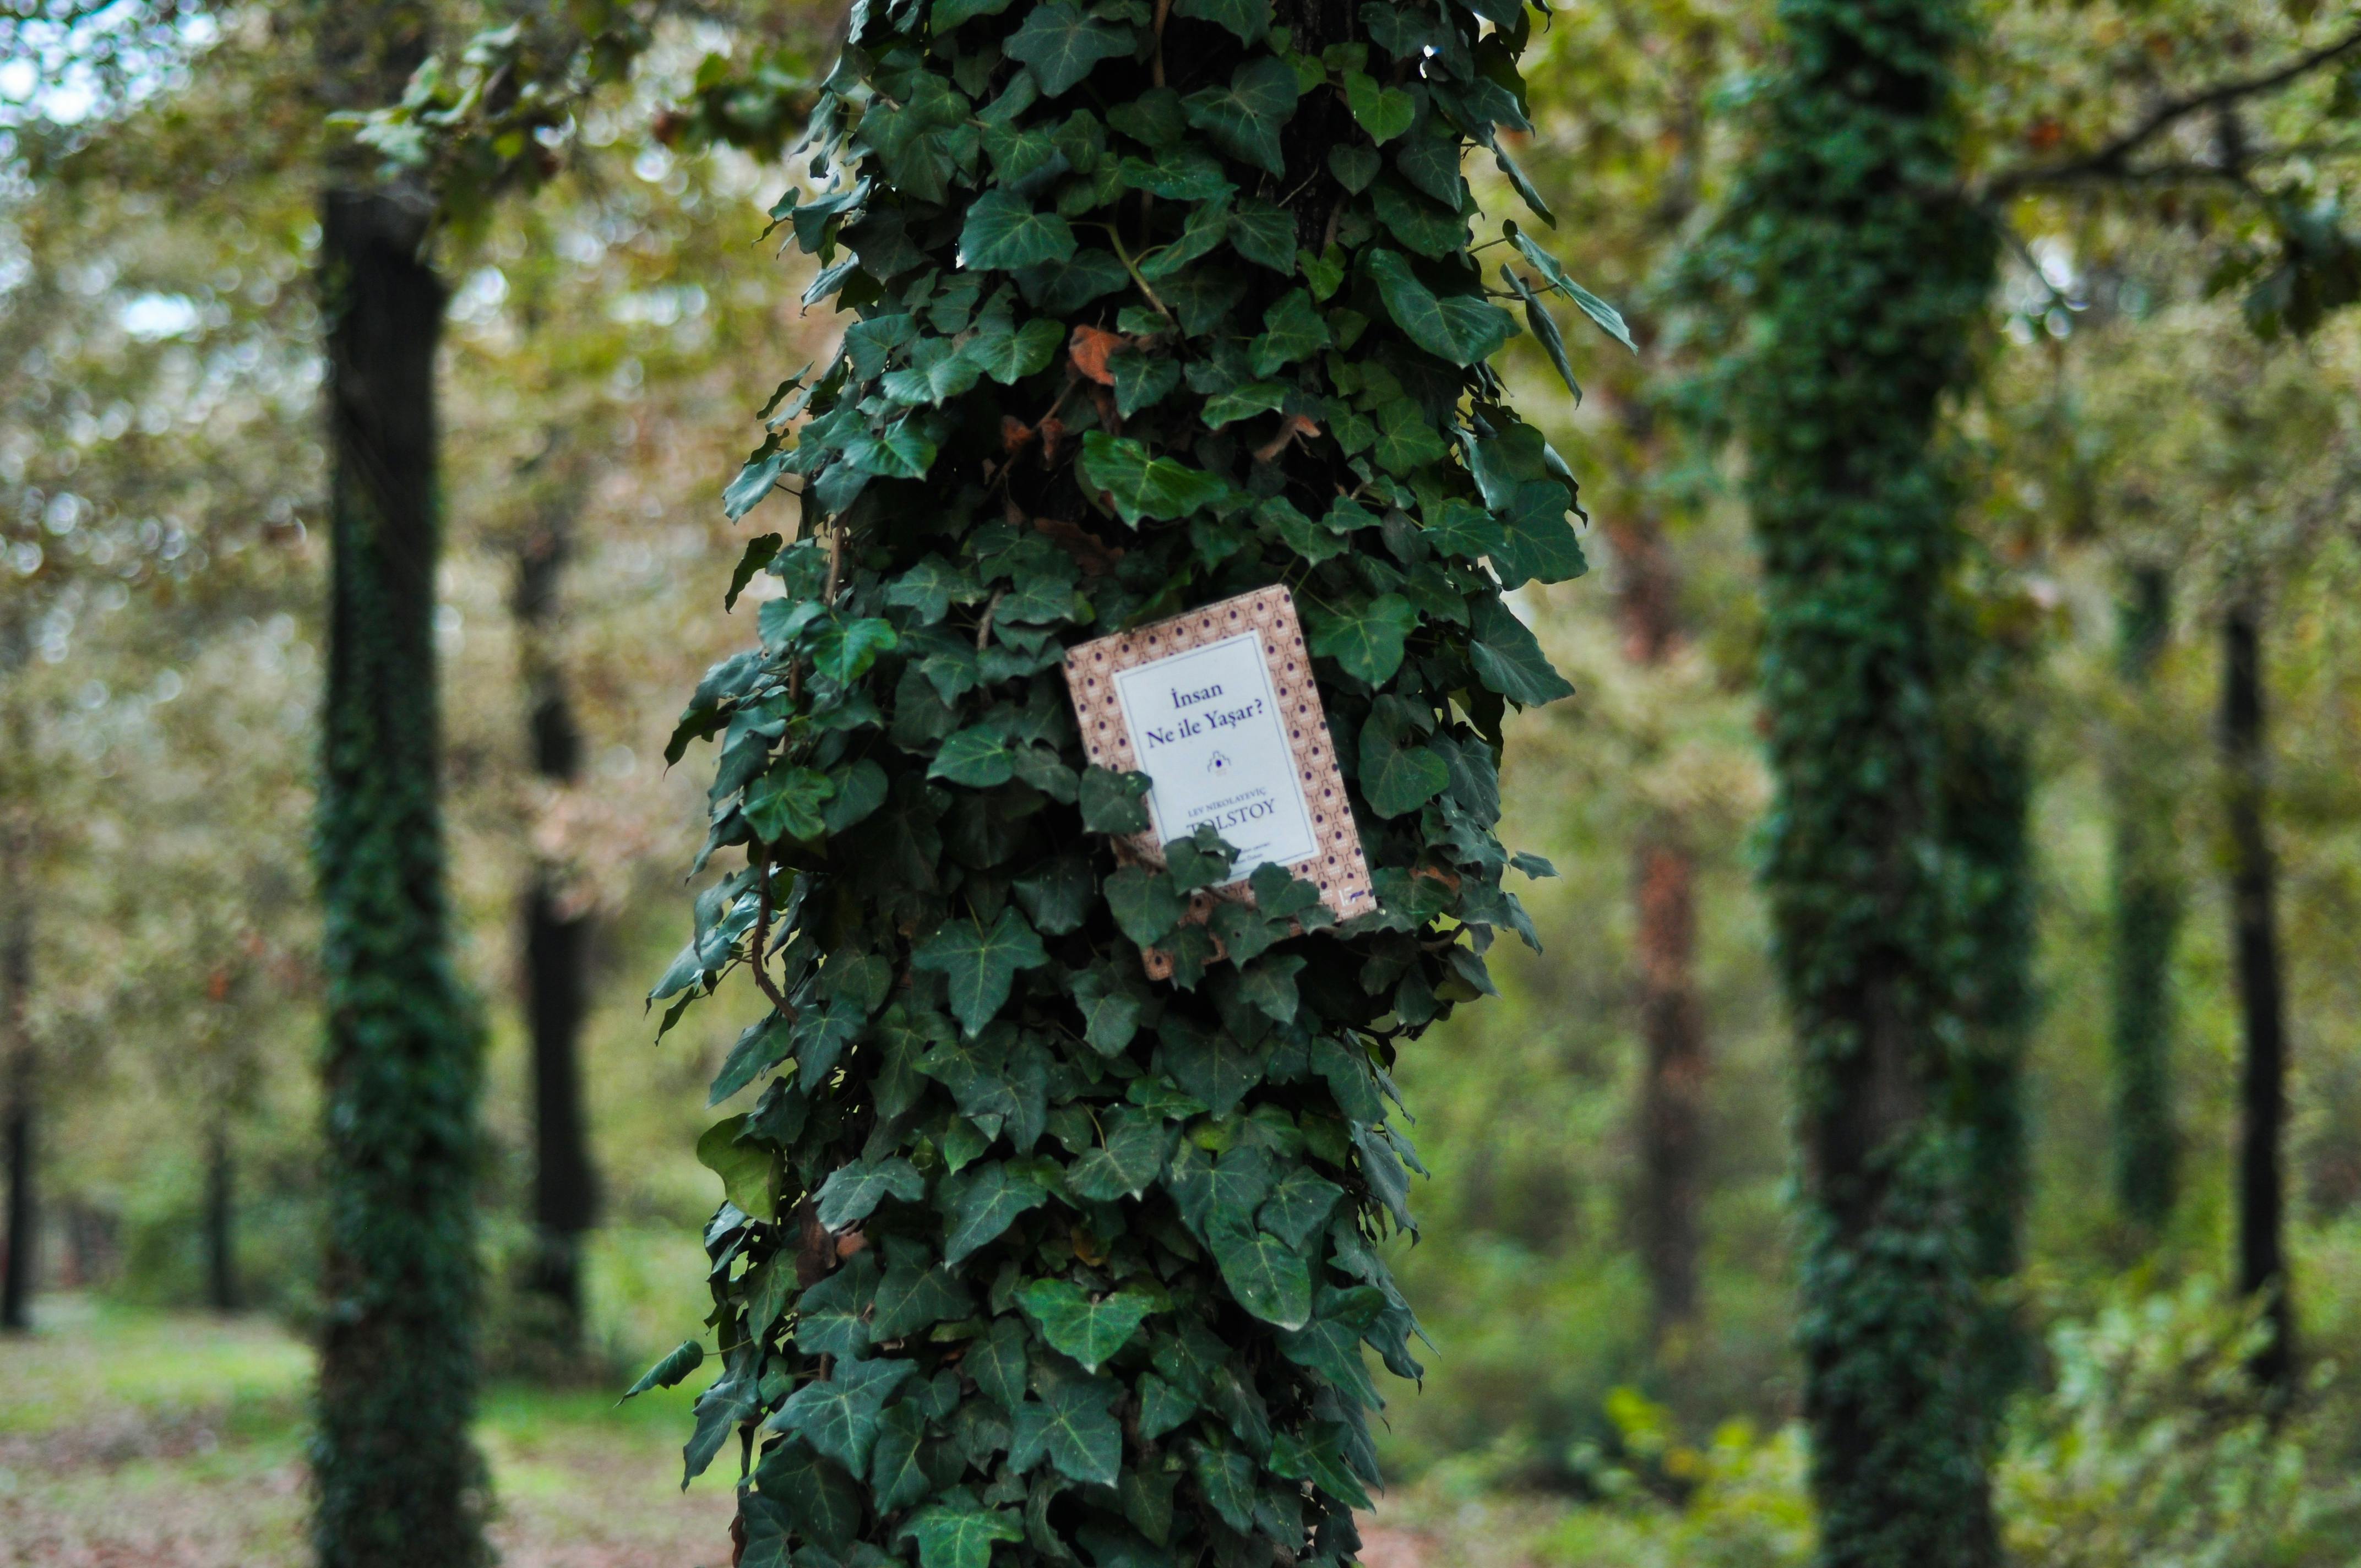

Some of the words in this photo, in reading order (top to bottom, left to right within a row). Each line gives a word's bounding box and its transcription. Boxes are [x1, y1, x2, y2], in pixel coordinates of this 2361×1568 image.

[1171, 684, 1223, 709] İnsan
[1146, 727, 1174, 748] Ne
[1178, 718, 1201, 738] ile
[1204, 698, 1263, 729] Yaşar?
